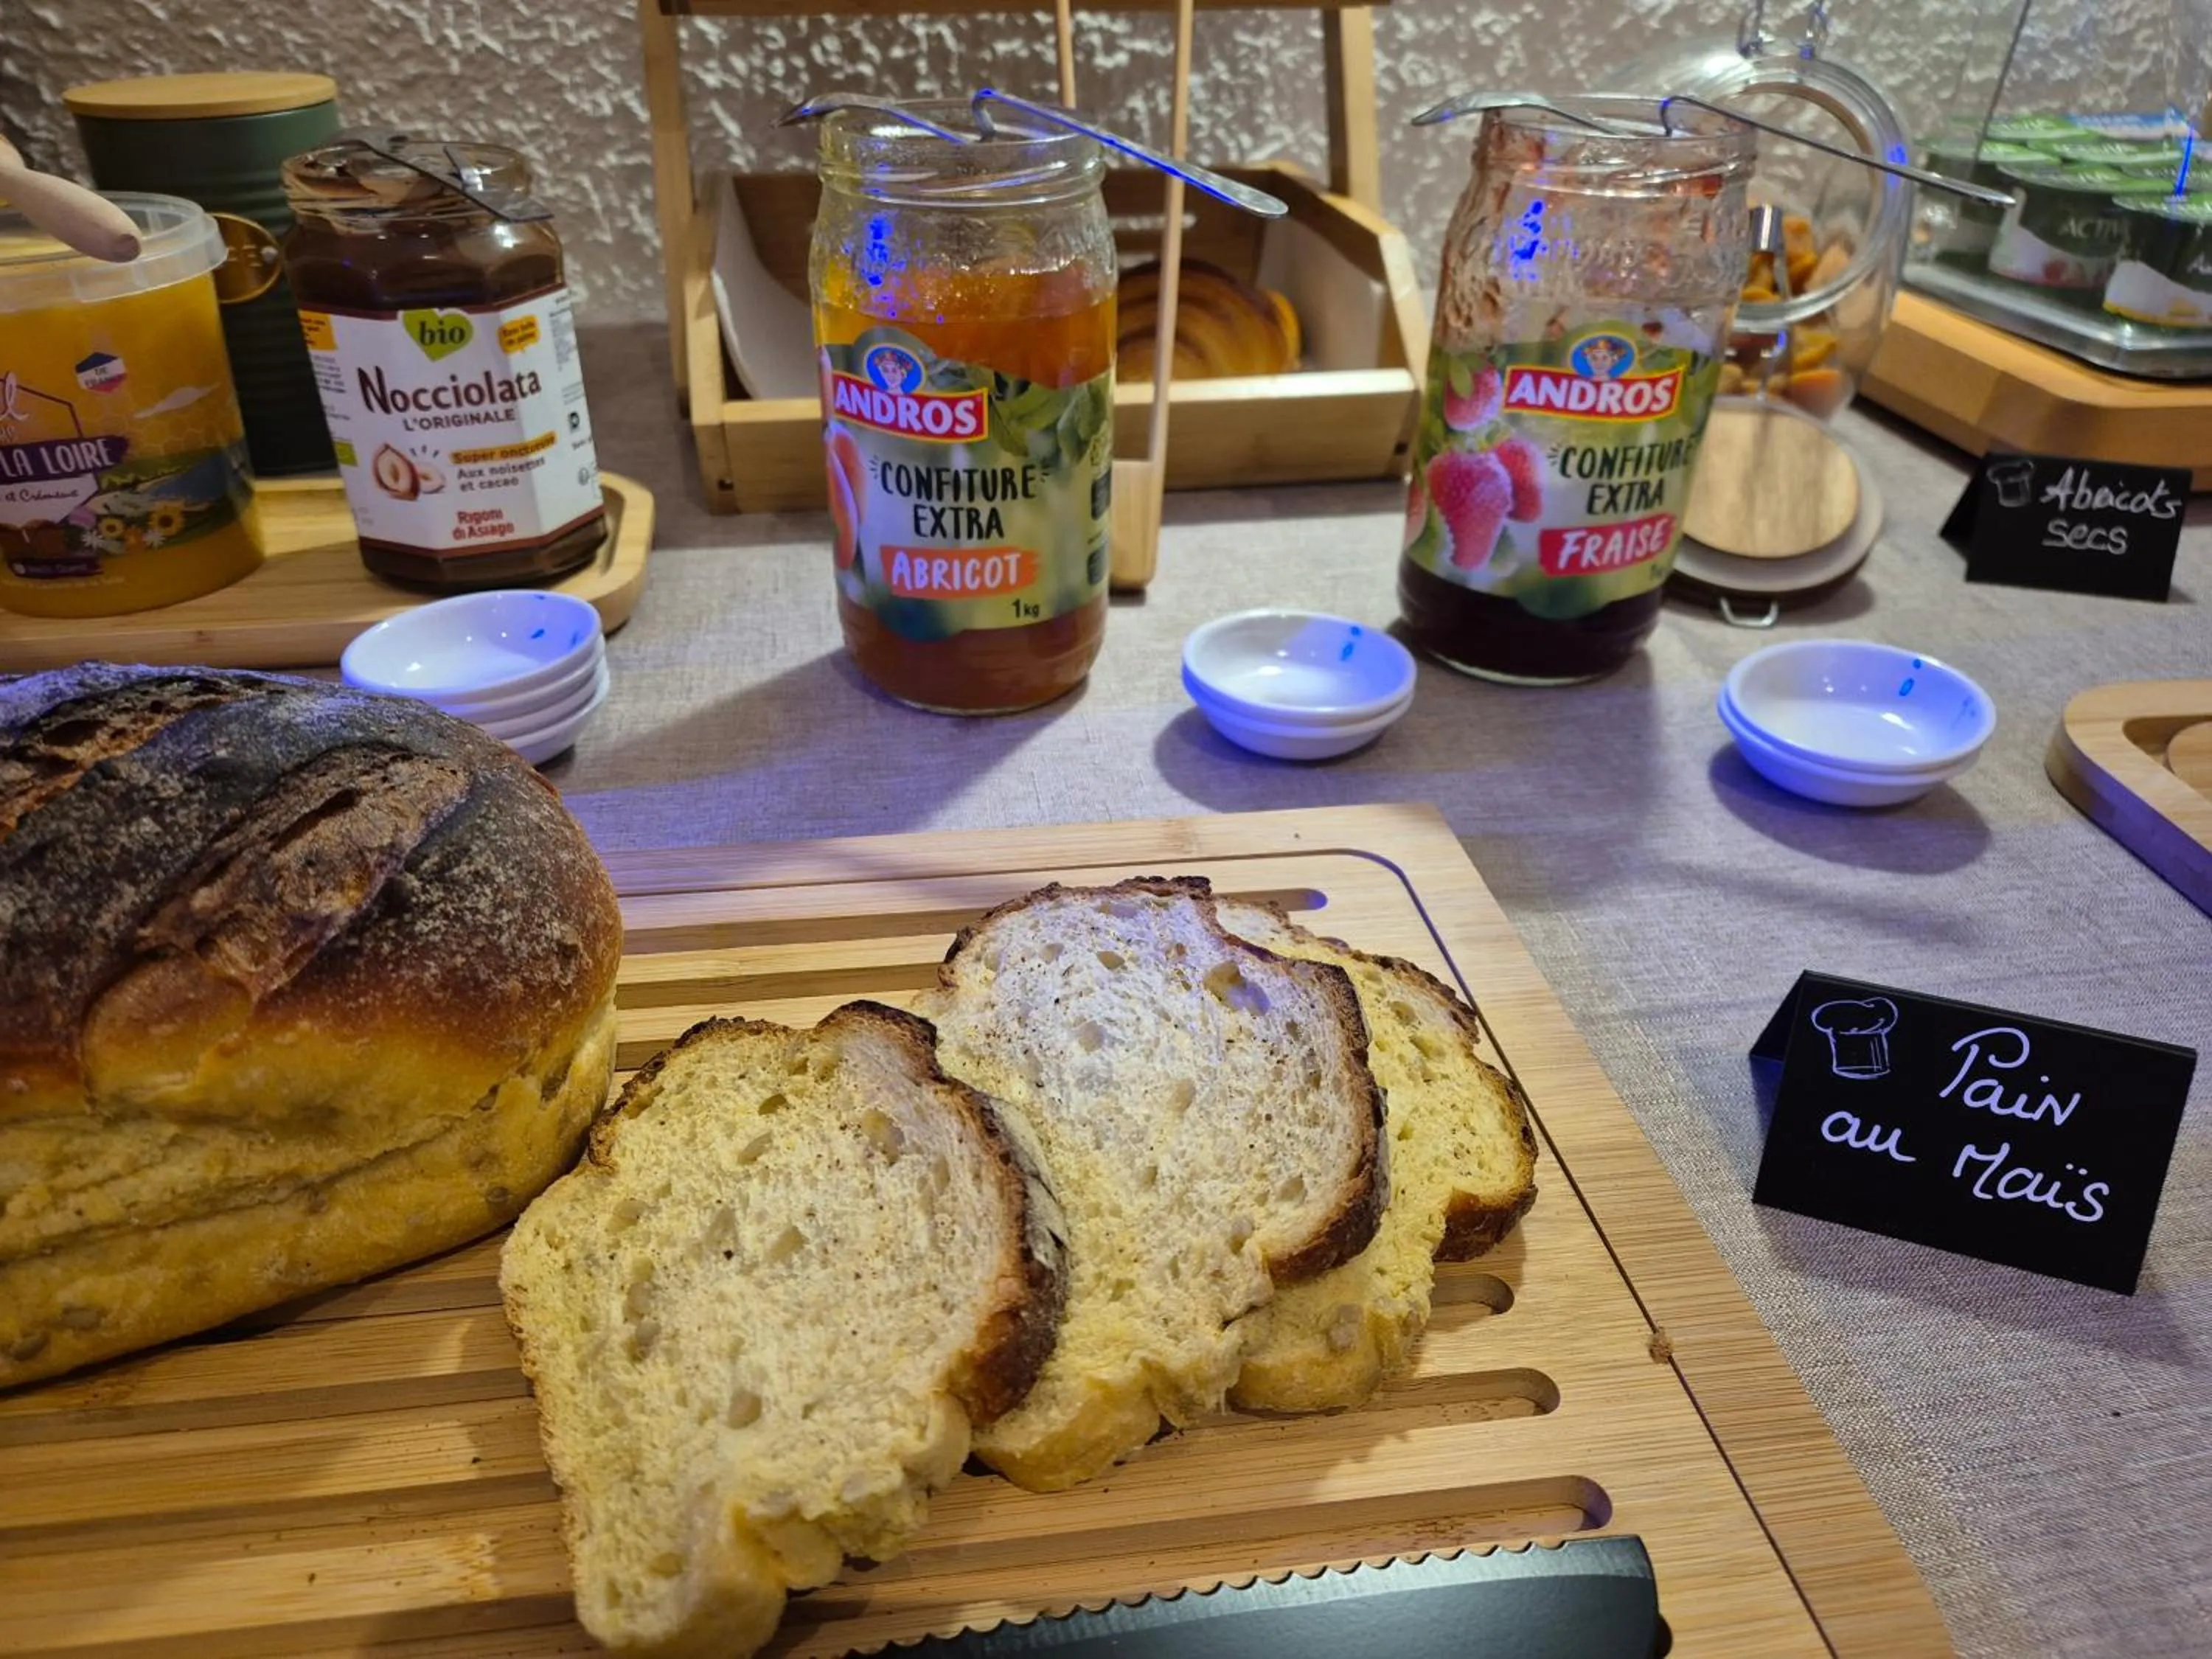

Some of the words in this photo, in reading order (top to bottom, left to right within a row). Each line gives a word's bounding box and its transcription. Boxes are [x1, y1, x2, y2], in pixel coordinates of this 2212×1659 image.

[419, 321, 465, 345] bio
[357, 366, 542, 414] Nocciolata
[835, 383, 977, 434] ANDROS
[1509, 375, 1673, 414] ANDROS
[403, 408, 517, 432] L'ORIGINALE
[0, 448, 34, 477] LA
[39, 439, 115, 474] LOIRE
[457, 467, 485, 479] Aux
[1559, 437, 1694, 479] CONFITURE
[479, 477, 519, 490] cacao
[880, 462, 1037, 502] CONFITURE
[1587, 479, 1664, 515] EXTRA
[2040, 466, 2182, 519] Abricots
[914, 504, 1004, 539] EXTRA
[1558, 518, 1669, 569] FRAISE
[891, 552, 1021, 591] ABRICOT
[1821, 1110, 1916, 1162] au
[1952, 1142, 2110, 1222] Maïs
